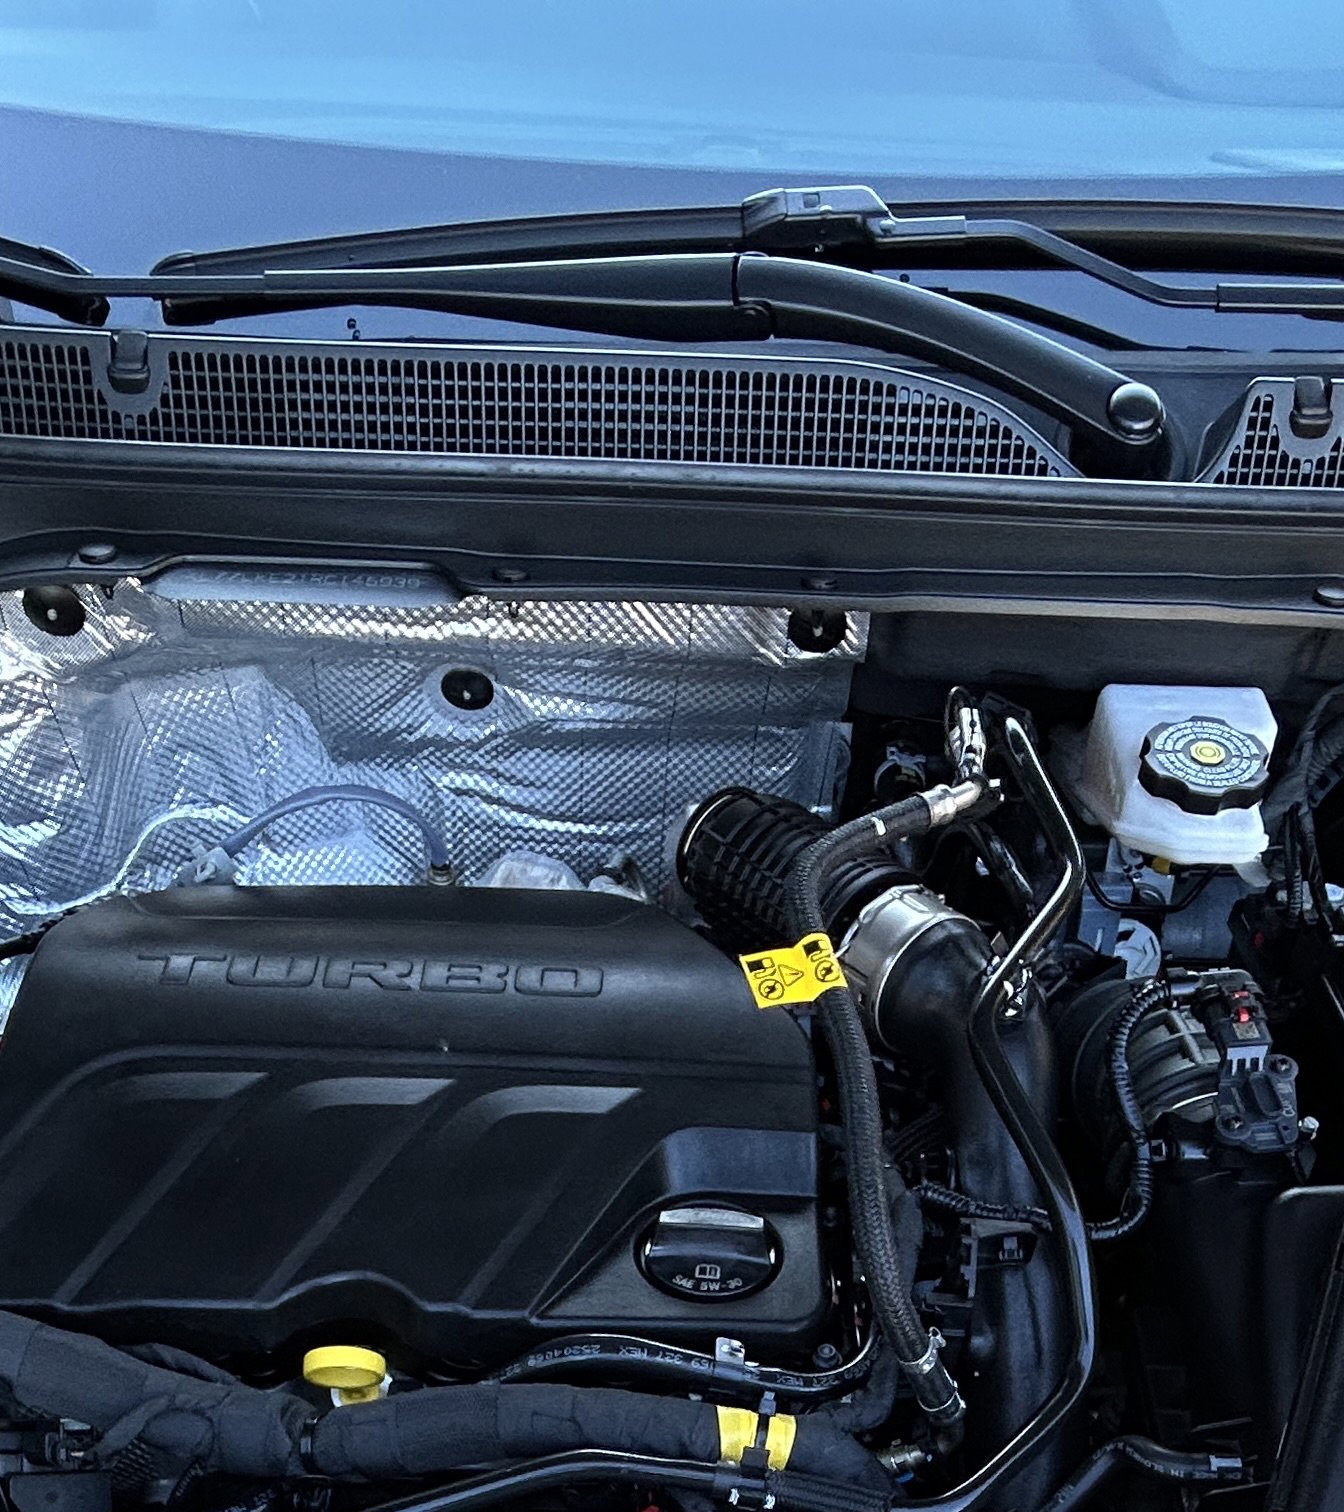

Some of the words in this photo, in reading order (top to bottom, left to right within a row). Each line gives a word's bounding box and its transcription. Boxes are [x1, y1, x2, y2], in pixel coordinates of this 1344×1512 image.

[136, 953, 608, 998] TURBO
[672, 1275, 695, 1289] SAE
[700, 1278, 743, 1291] 5W-30
[618, 1344, 648, 1359] MEX
